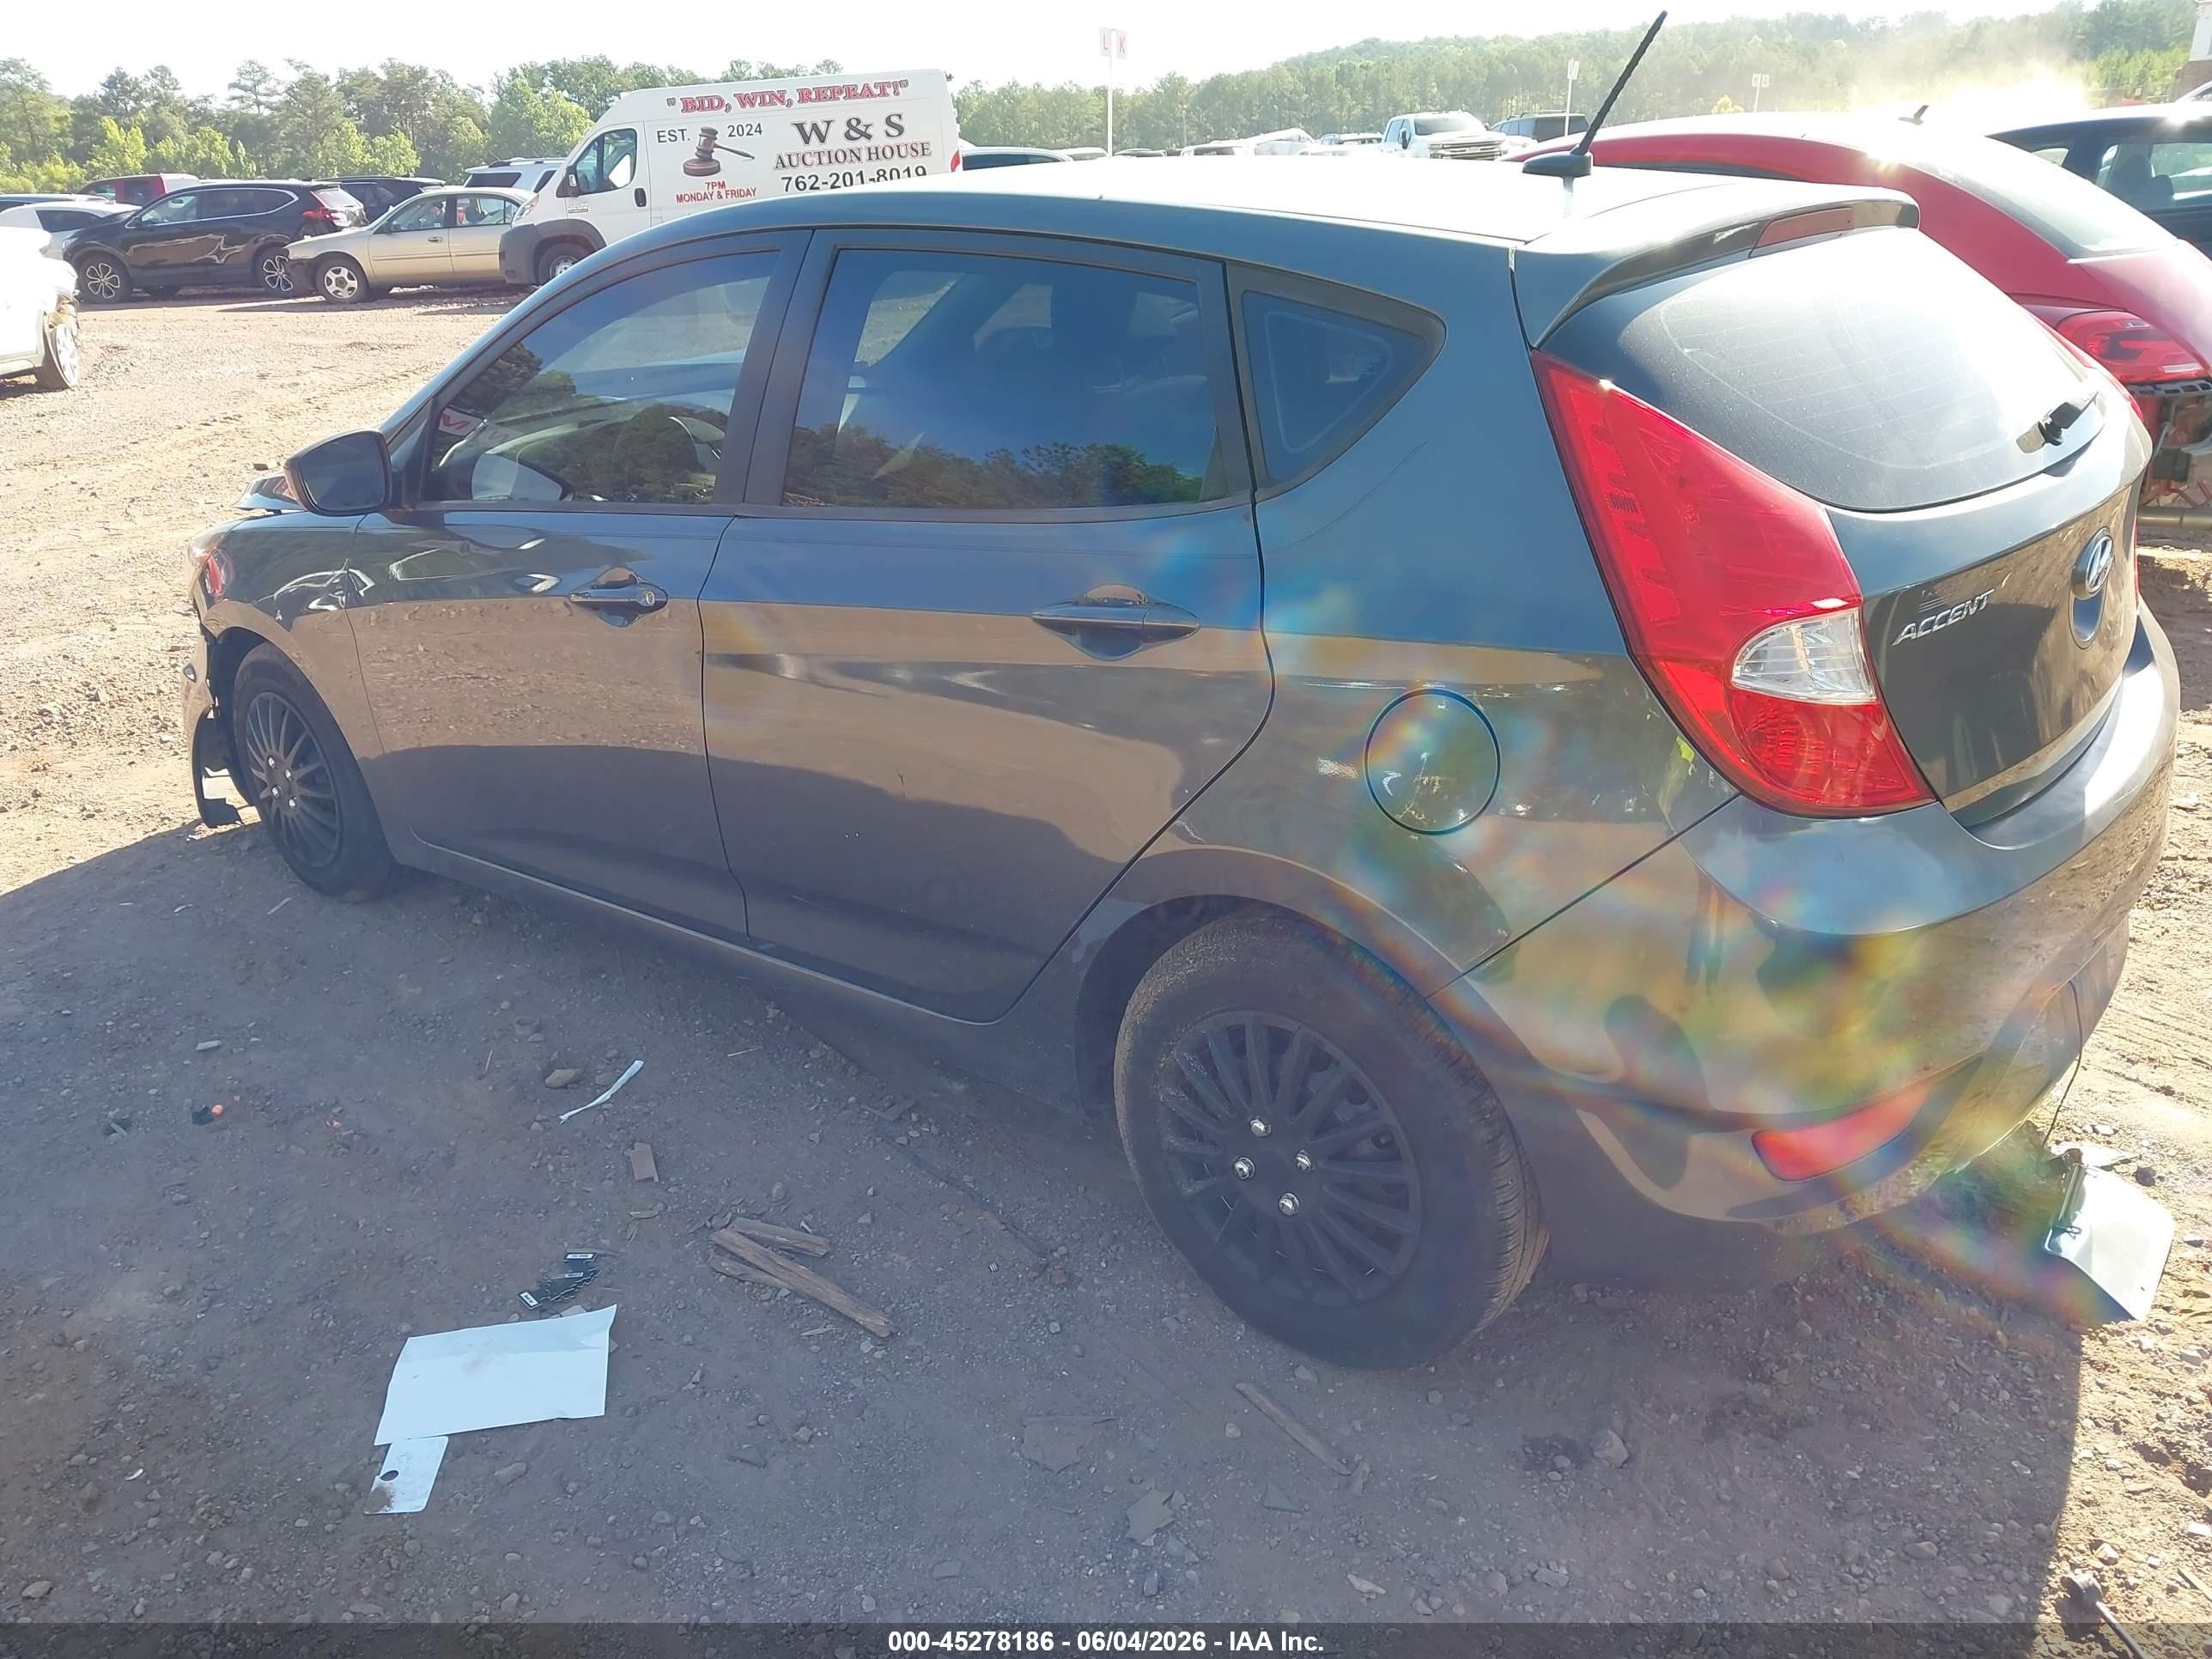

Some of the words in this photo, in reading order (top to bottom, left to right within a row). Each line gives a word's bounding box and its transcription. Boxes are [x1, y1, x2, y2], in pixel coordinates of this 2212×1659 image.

[734, 89, 793, 108] WIN,
[657, 129, 690, 143] EST.
[727, 123, 763, 137] 2024
[792, 119, 834, 145] W
[844, 117, 873, 141] &
[884, 113, 905, 137] S
[775, 148, 862, 169] AUCTION
[866, 142, 933, 161] HOUSE
[676, 191, 714, 204] MONDAY
[716, 190, 724, 200] &
[726, 188, 757, 199] FRIDAY
[705, 181, 726, 191] 7PM
[1891, 589, 1995, 646] ACCENT
